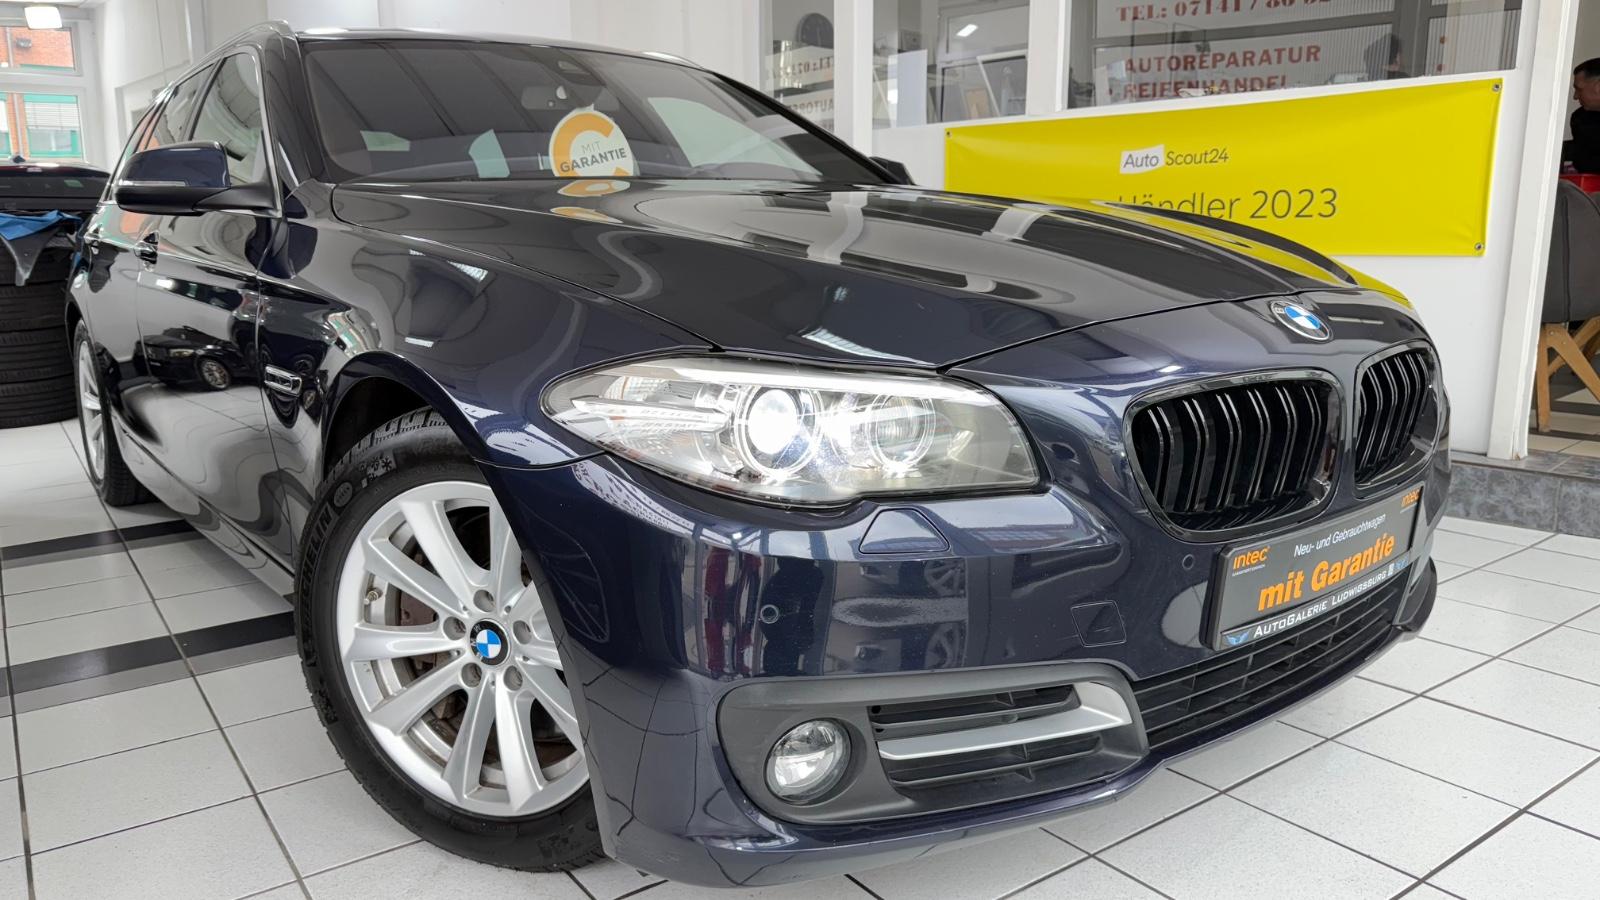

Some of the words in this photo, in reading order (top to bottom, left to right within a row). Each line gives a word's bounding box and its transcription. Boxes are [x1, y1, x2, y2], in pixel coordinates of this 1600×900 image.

[1116, 5, 1167, 22] TEL:
[1174, 0, 1242, 18] 07141
[1125, 45, 1321, 74] AUTOREPARATUR
[560, 148, 627, 173] GARANTIE
[581, 141, 601, 154] MIT
[1123, 152, 1160, 169] Auto
[1165, 148, 1229, 166] Scout24
[1250, 188, 1337, 219] 2023
[1294, 543, 1314, 557] Neu-
[1316, 534, 1331, 549] und
[1332, 514, 1386, 544] Gebrauchtwagen
[1258, 570, 1304, 612] mit
[1311, 532, 1395, 592] Garantie
[1253, 601, 1328, 638] AUTOGALERIE
[1332, 570, 1387, 605] LUDWIGSBURG
